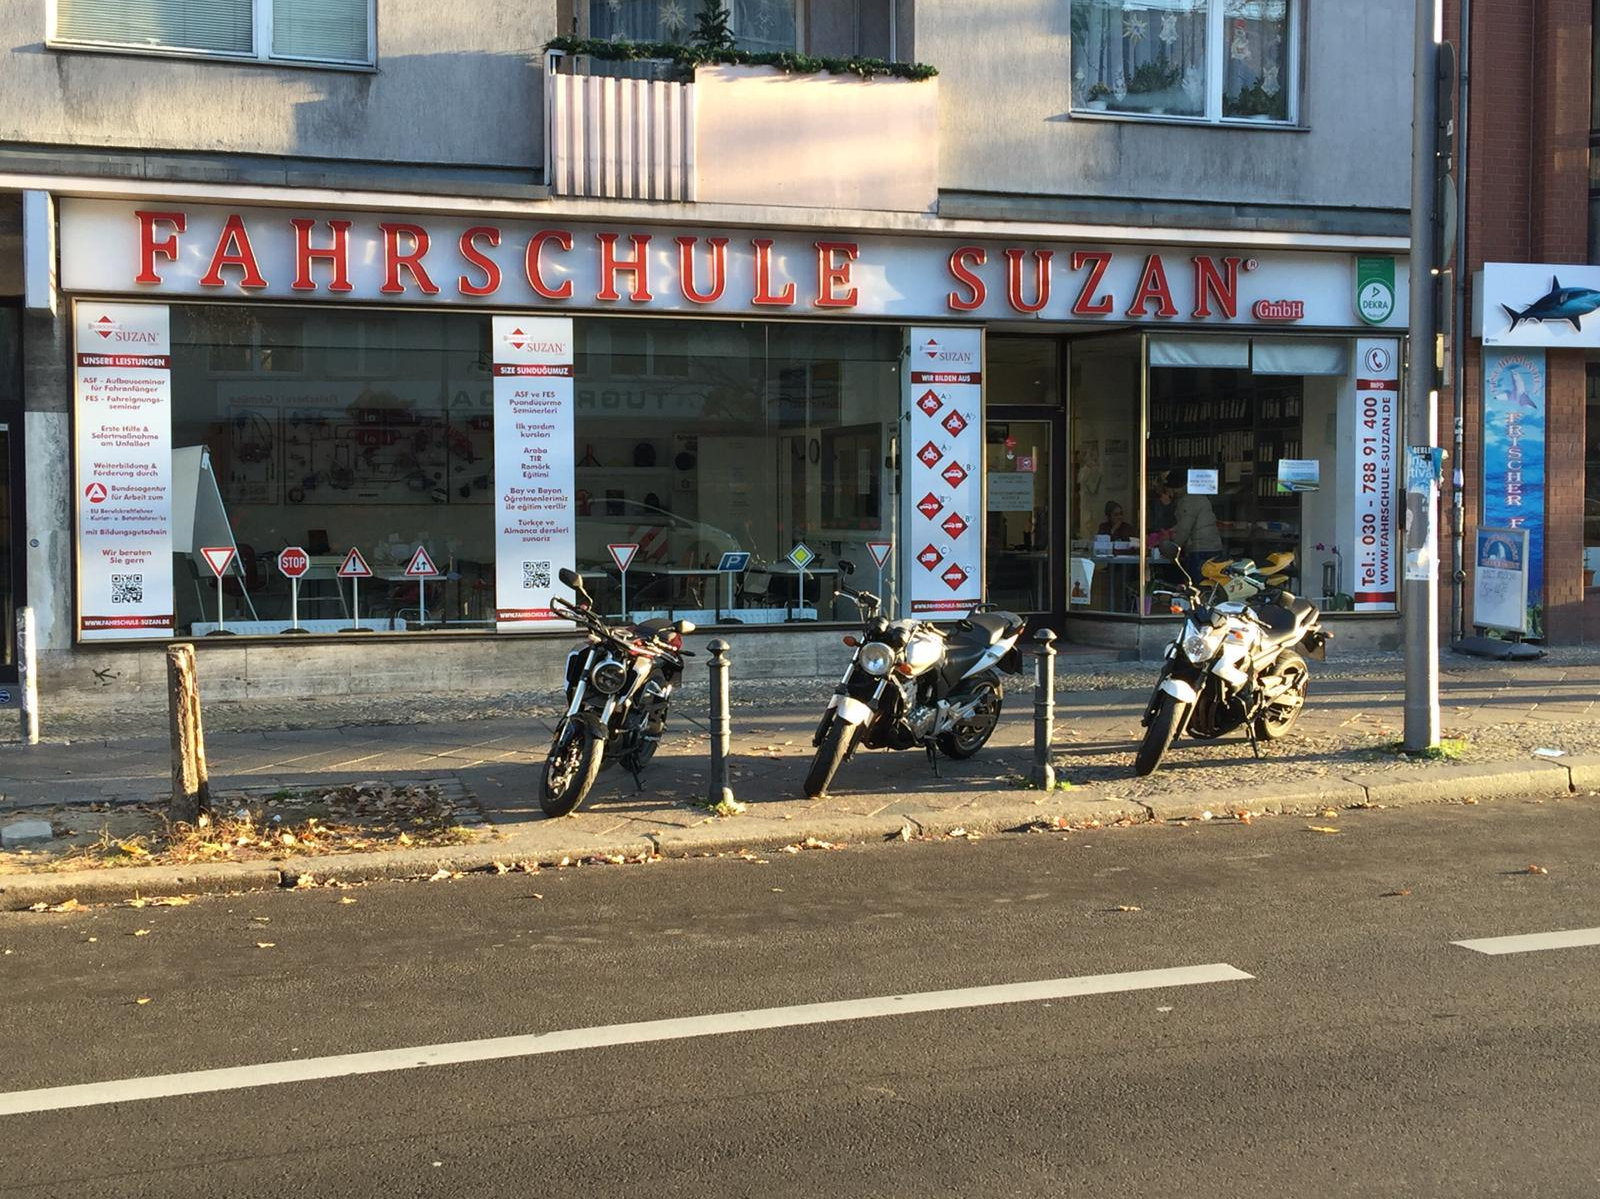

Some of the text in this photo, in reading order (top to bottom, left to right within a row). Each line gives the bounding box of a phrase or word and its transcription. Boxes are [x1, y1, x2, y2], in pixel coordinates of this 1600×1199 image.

[134, 210, 858, 307] FAHRSCHULE
[1258, 301, 1303, 318] GmbH
[1363, 300, 1389, 309] DEKRA
[82, 356, 165, 366] UNSERE LEISTUNGEN
[106, 377, 165, 385] Aufbauseminar
[921, 374, 933, 382] WIR
[934, 374, 957, 382] BILDEN
[104, 385, 158, 393] Fahranfänger
[1363, 397, 1378, 430] 400
[1363, 438, 1377, 456] 91
[1505, 411, 1524, 507] FRISCHER
[1362, 462, 1377, 494] 788
[111, 485, 166, 493] Bundesagentur
[538, 487, 562, 495] Bayan
[1380, 396, 1391, 586] WWW.FAHRSCHULE-SUZAN.DE
[539, 526, 569, 534] dersleri
[1362, 513, 1376, 546] 030
[282, 556, 306, 568] STOP
[726, 555, 741, 568] P
[1361, 552, 1376, 587] Tel.:
